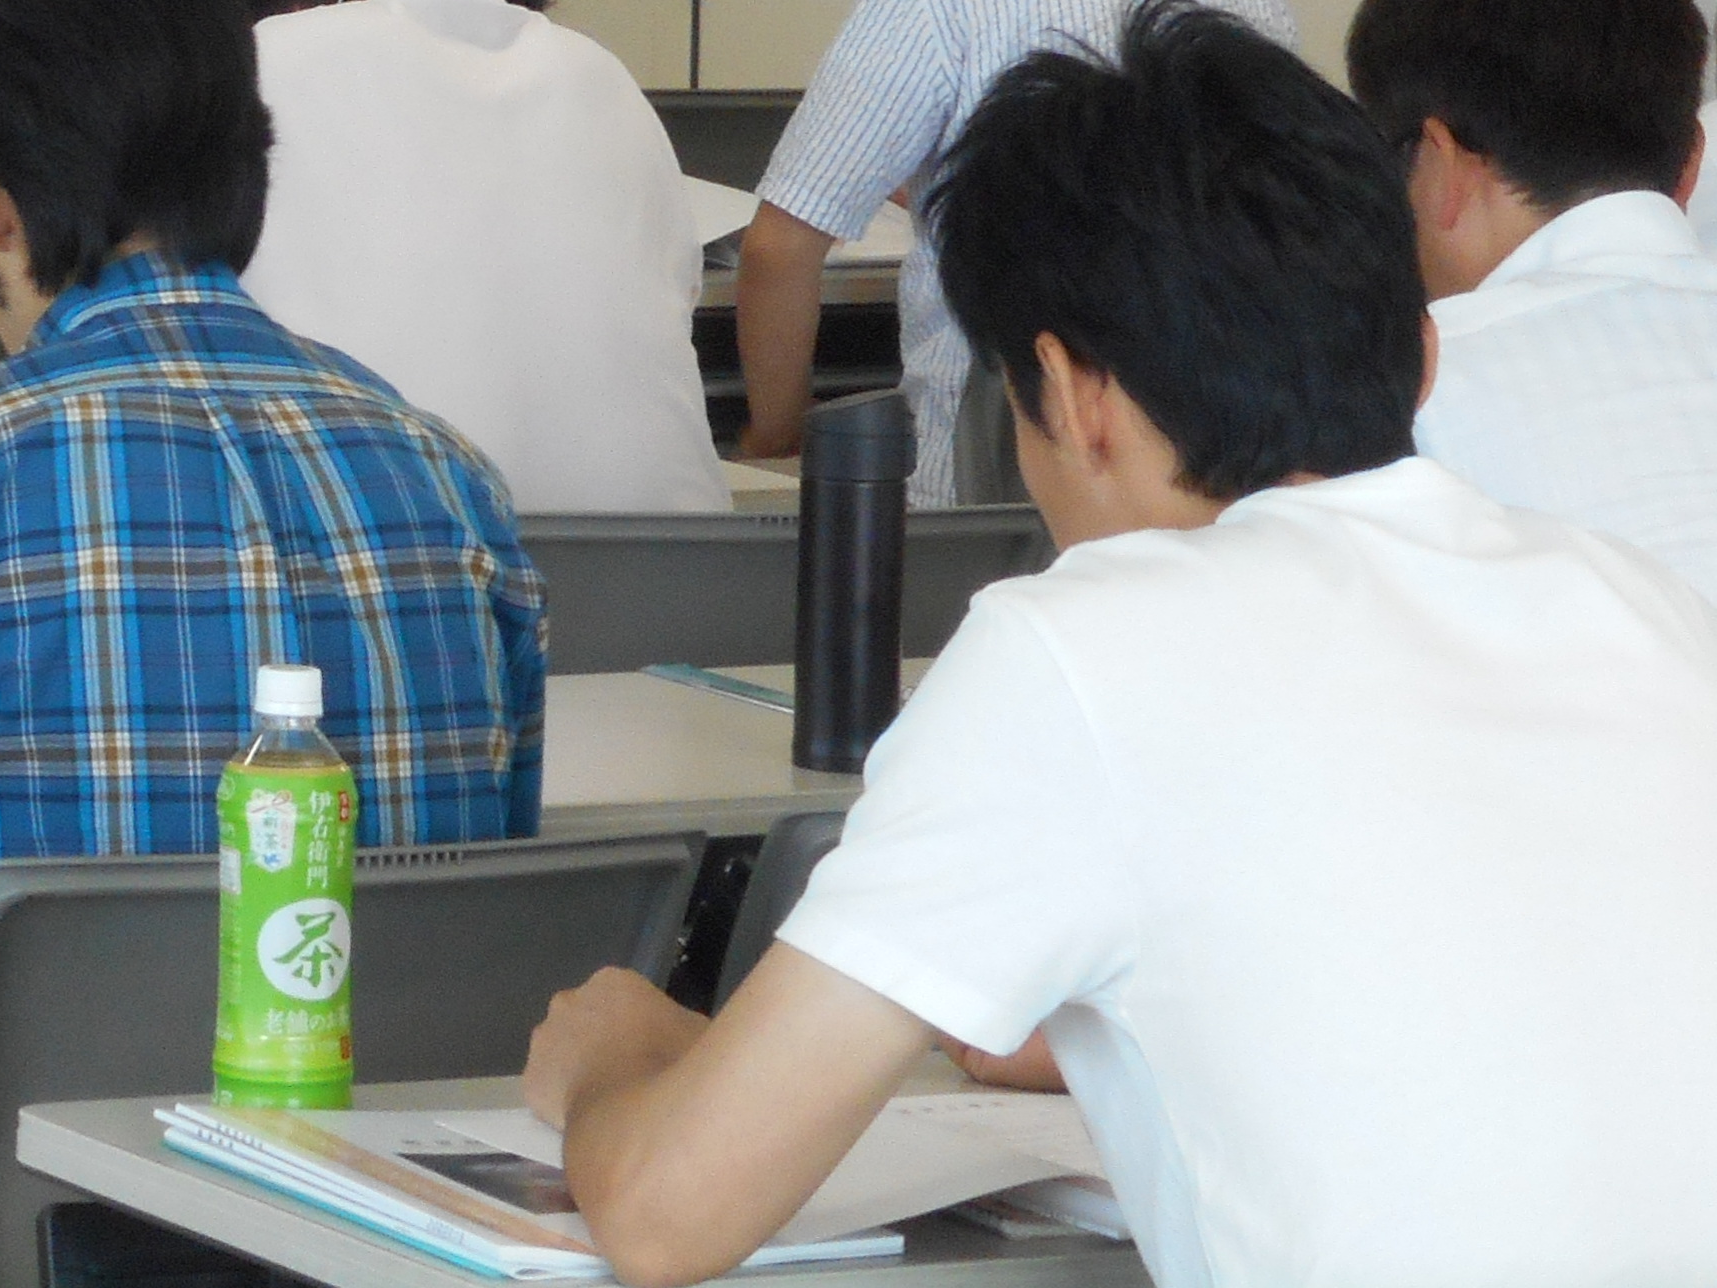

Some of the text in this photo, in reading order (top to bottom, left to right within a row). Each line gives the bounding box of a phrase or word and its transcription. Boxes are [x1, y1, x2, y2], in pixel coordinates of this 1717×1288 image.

[307, 790, 333, 889] 伊右衛門
[273, 911, 343, 988] 茶
